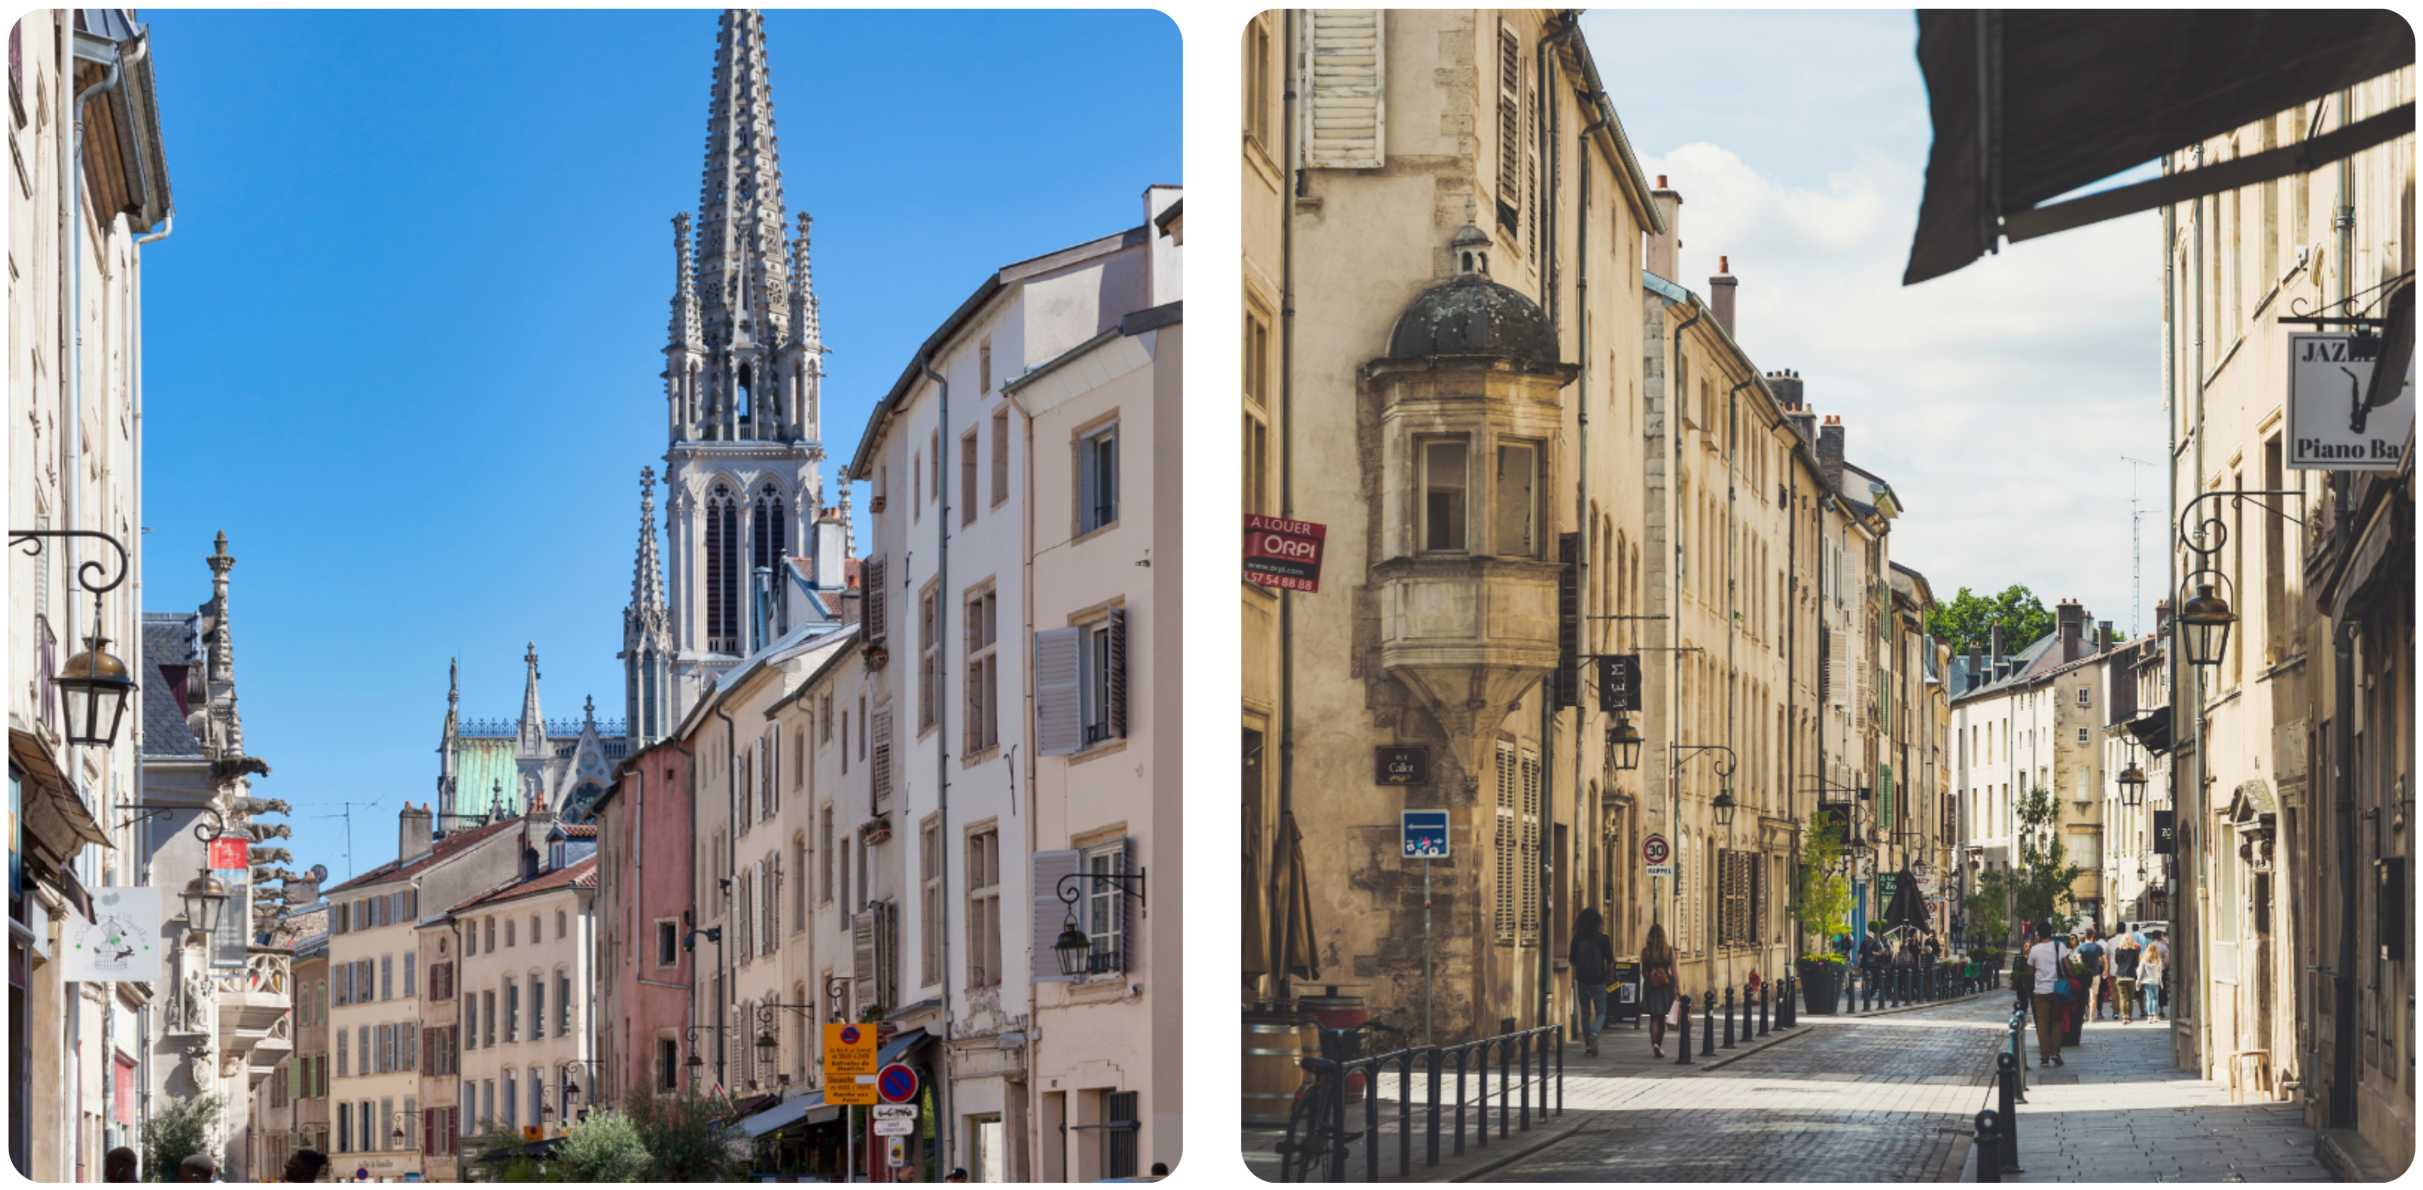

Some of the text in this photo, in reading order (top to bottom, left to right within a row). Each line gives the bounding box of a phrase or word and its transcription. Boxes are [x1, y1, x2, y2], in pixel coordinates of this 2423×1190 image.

[2297, 438, 2365, 459] Piano
[1250, 516, 1311, 535] A LOUER
[1264, 535, 1316, 558] ORPI
[1247, 562, 1305, 575] www.orpi.com
[1251, 572, 1264, 583] 57
[1266, 574, 1280, 586] 54
[1281, 577, 1296, 588] 88
[1298, 579, 1312, 590] 88
[1389, 762, 1414, 772] Callot
[1648, 844, 1665, 857] 30
[827, 1075, 854, 1084] Dimanche
